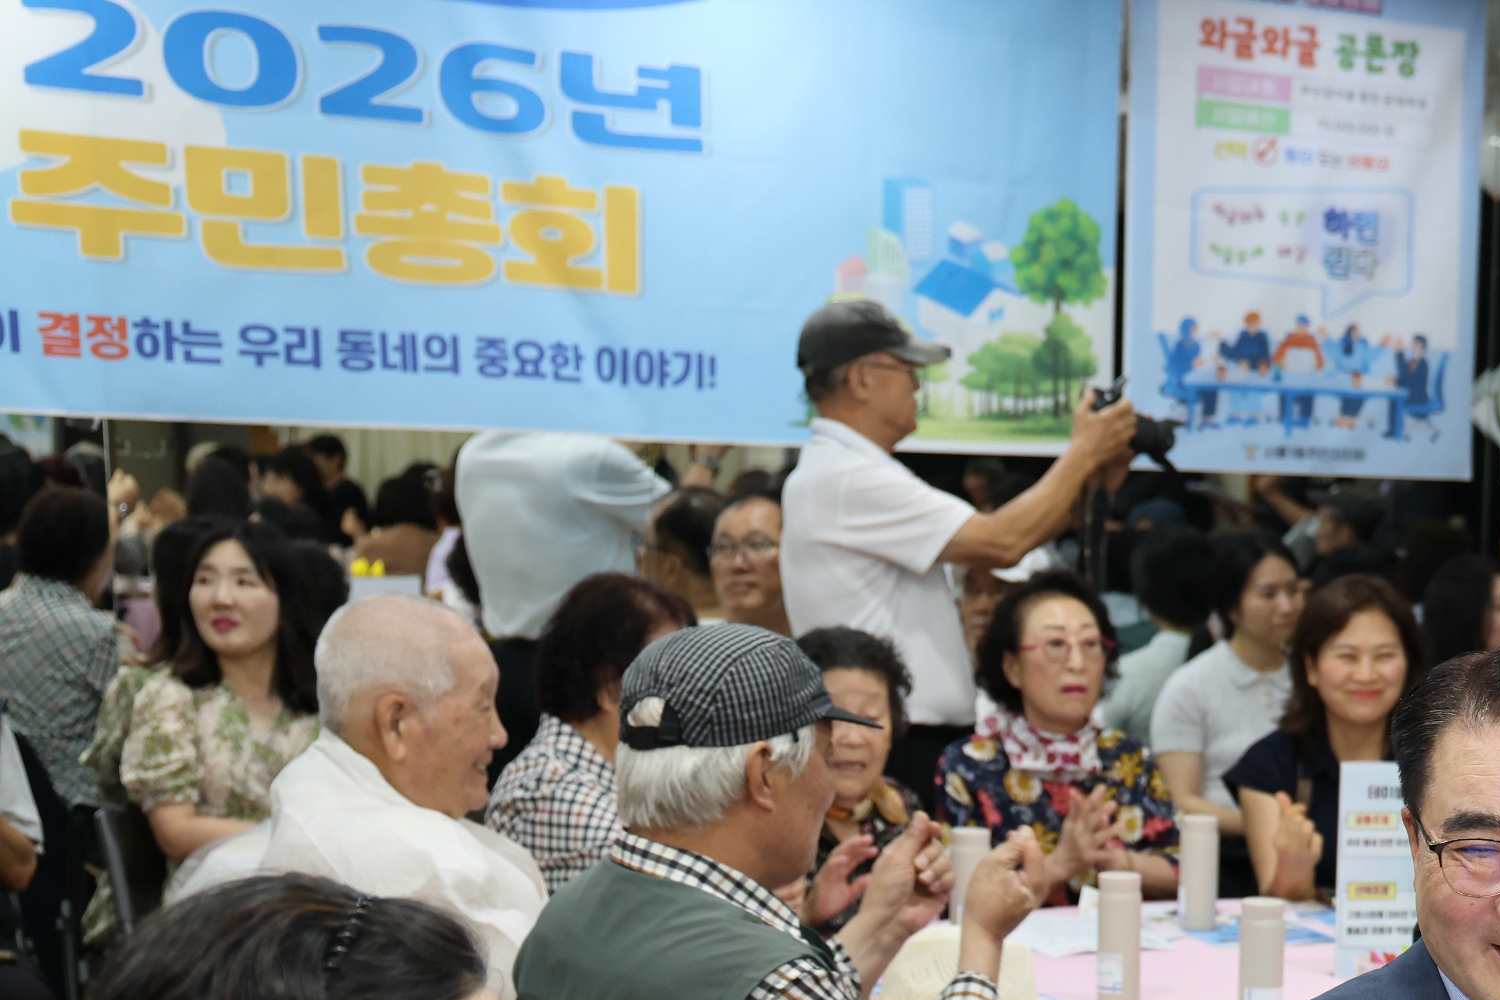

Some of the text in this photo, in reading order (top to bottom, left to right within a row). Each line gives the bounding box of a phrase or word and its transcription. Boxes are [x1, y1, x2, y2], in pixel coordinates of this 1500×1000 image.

[23, 0, 704, 152] 2026년
[1198, 15, 1421, 78] 와글와글 공론장
[10, 128, 641, 294] 주민총회
[37, 310, 223, 365] 결정하는
[238, 323, 323, 369] 우리
[336, 330, 461, 376] 동네의
[474, 336, 584, 384] 중요한
[594, 349, 717, 390] 이야기!
